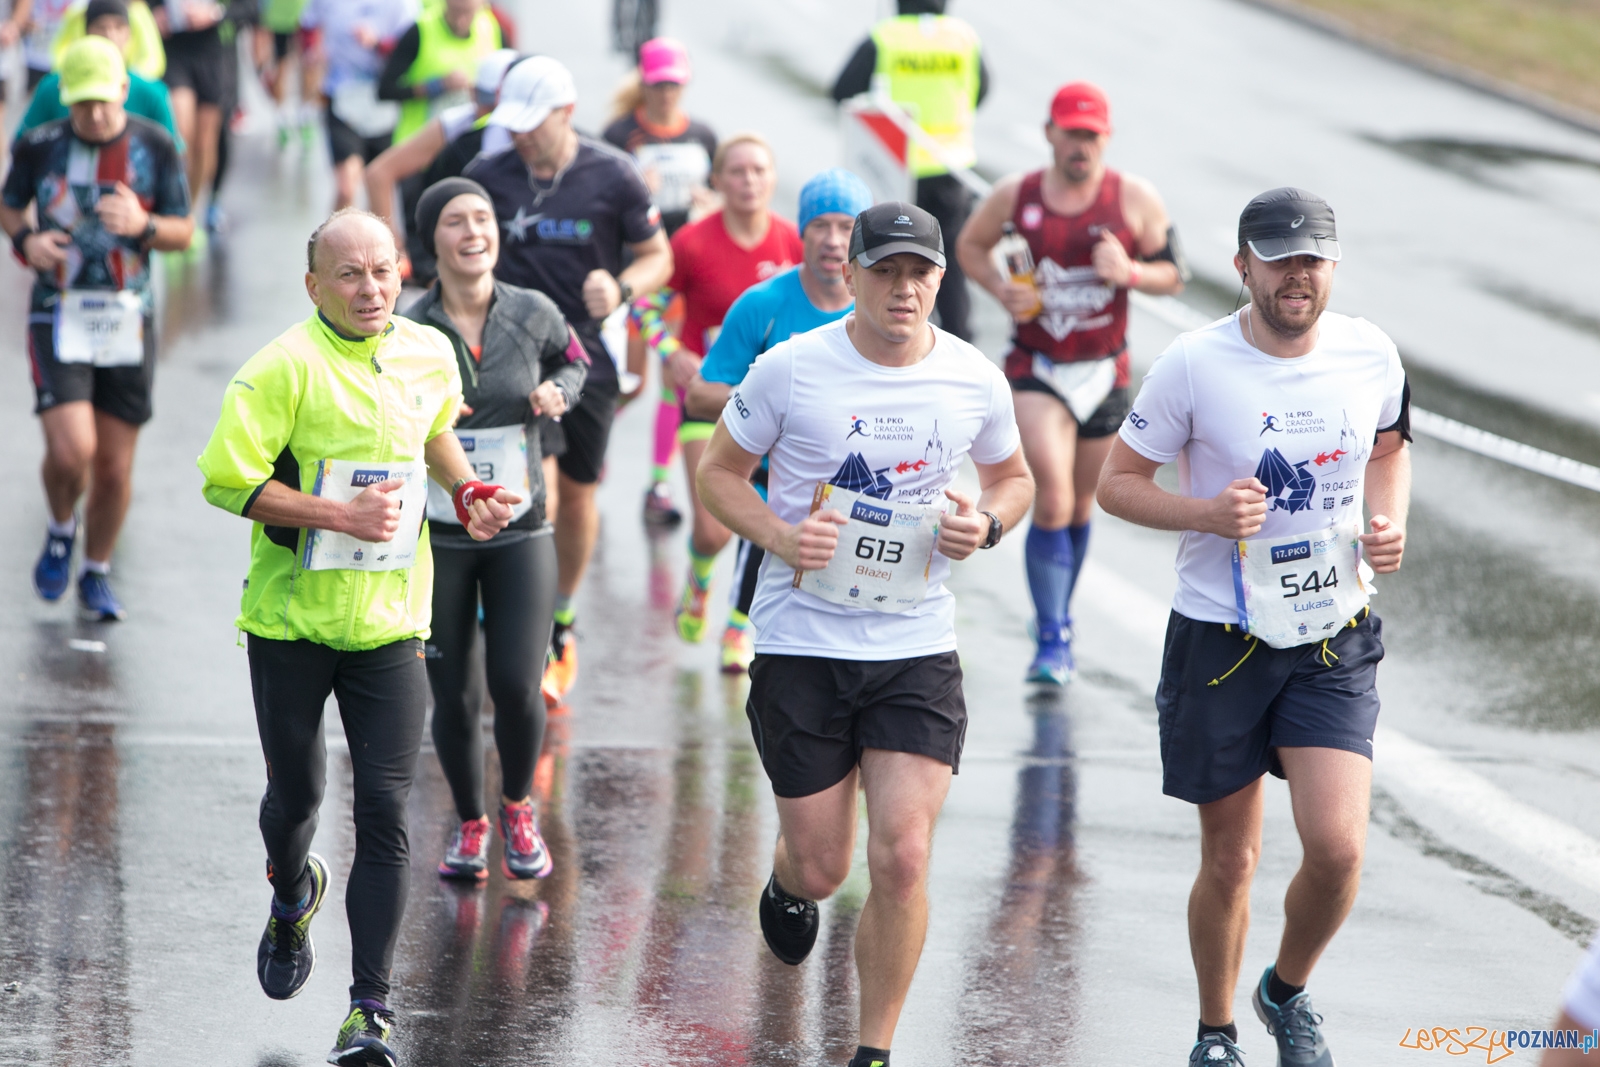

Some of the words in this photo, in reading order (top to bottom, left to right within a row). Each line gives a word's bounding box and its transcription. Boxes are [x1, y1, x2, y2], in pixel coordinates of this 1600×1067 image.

[1296, 410, 1313, 418] PKO
[1285, 418, 1326, 427] CRACOVIA
[873, 425, 915, 433] CRACOVIA
[1286, 426, 1326, 435] MARATON
[873, 433, 914, 441] MARATON
[855, 536, 905, 564] 613
[855, 565, 893, 581] Błażej
[1280, 565, 1339, 598] 544
[873, 595, 888, 603] 4F
[1293, 598, 1335, 613] Łukasz
[1322, 621, 1335, 630] 4F
